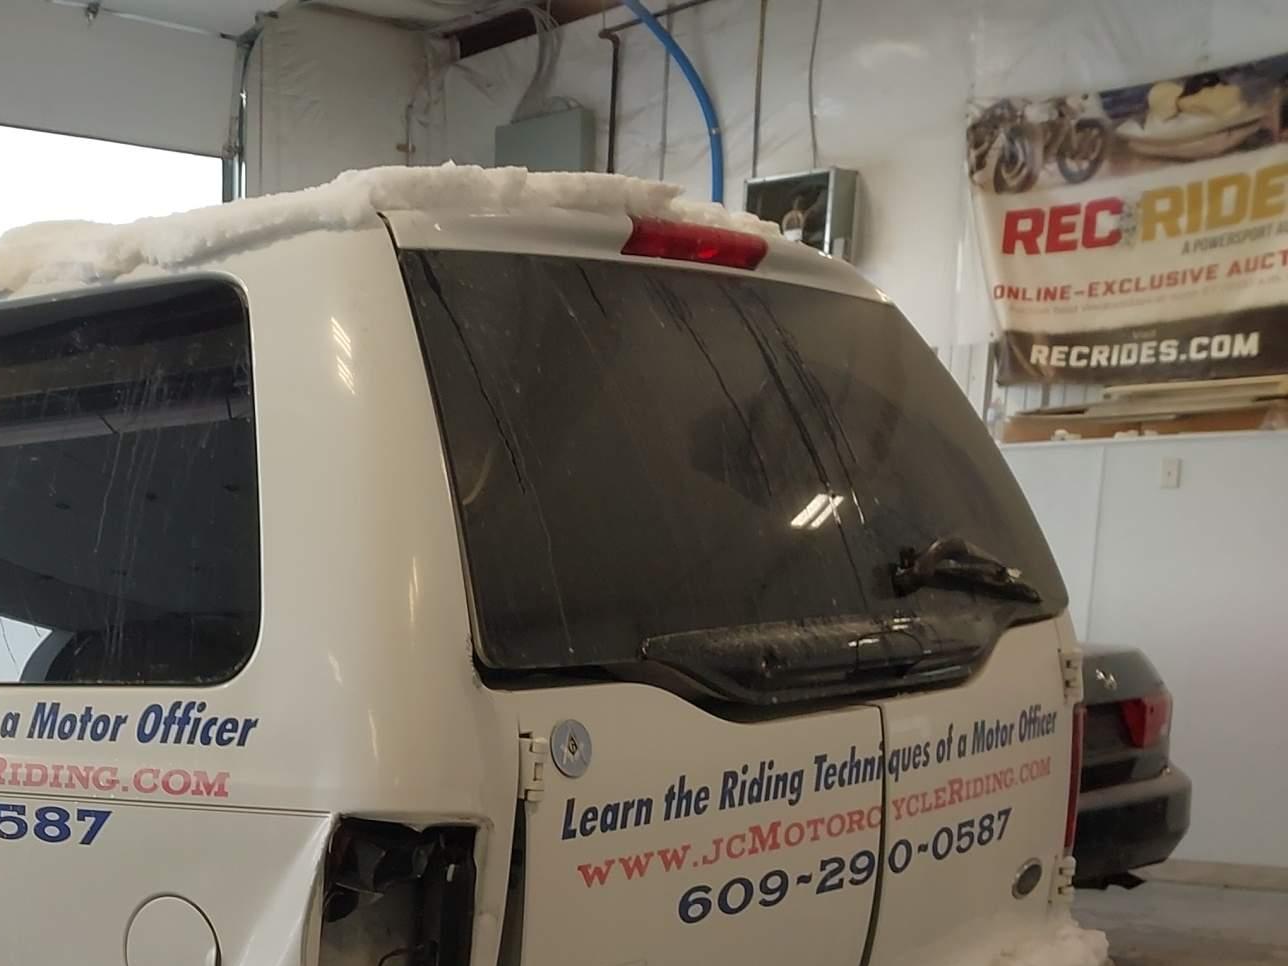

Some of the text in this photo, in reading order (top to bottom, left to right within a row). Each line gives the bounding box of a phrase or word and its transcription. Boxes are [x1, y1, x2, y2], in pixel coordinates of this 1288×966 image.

[1002, 197, 1123, 255] REC
[994, 264, 1219, 302] ONLINE-EXCLUSIVE
[1030, 332, 1260, 368] RECRIDES.COM
[0, 711, 18, 739] a
[28, 702, 128, 743] Motor
[136, 701, 259, 747] Officer
[562, 704, 1058, 840] Learn the Riding Techniques of a Motor Officer
